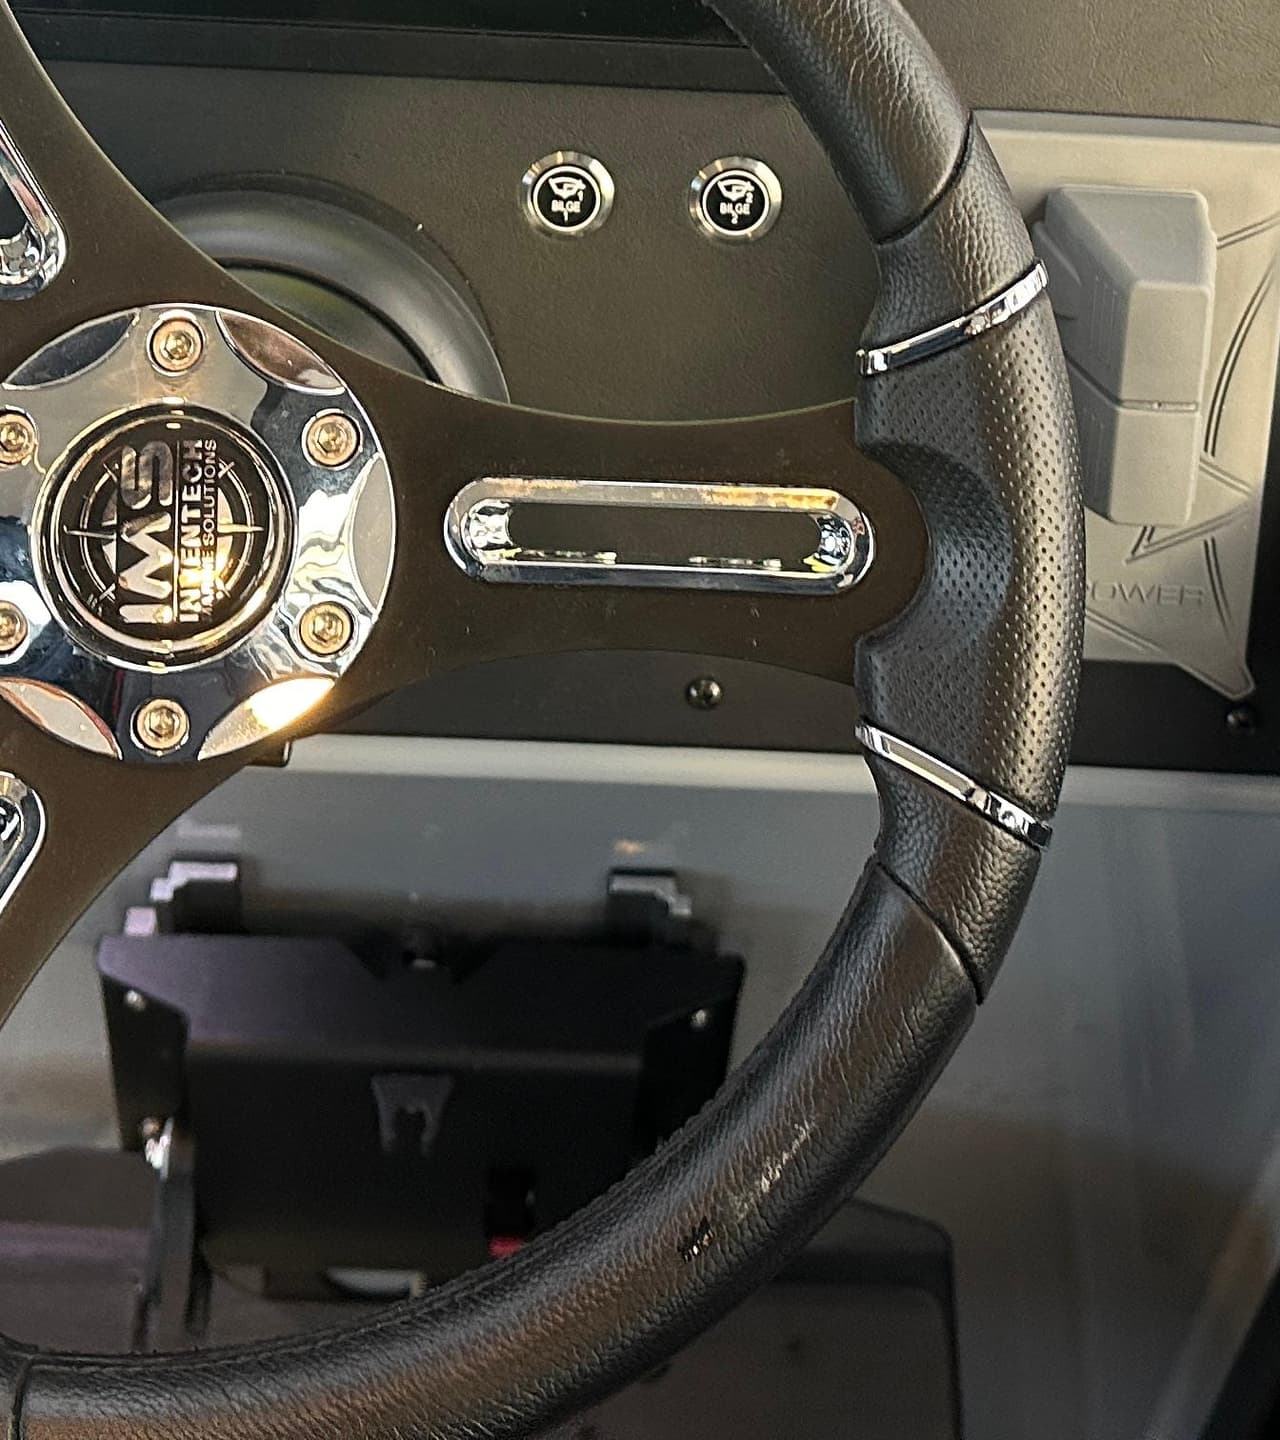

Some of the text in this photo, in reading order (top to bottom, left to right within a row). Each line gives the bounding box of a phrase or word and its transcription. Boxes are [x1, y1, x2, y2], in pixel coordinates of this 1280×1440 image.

[551, 199, 581, 214] BILGE
[719, 202, 751, 216] BILGE
[202, 438, 217, 547] SOLUTIONS
[1085, 581, 1204, 606] OWER
